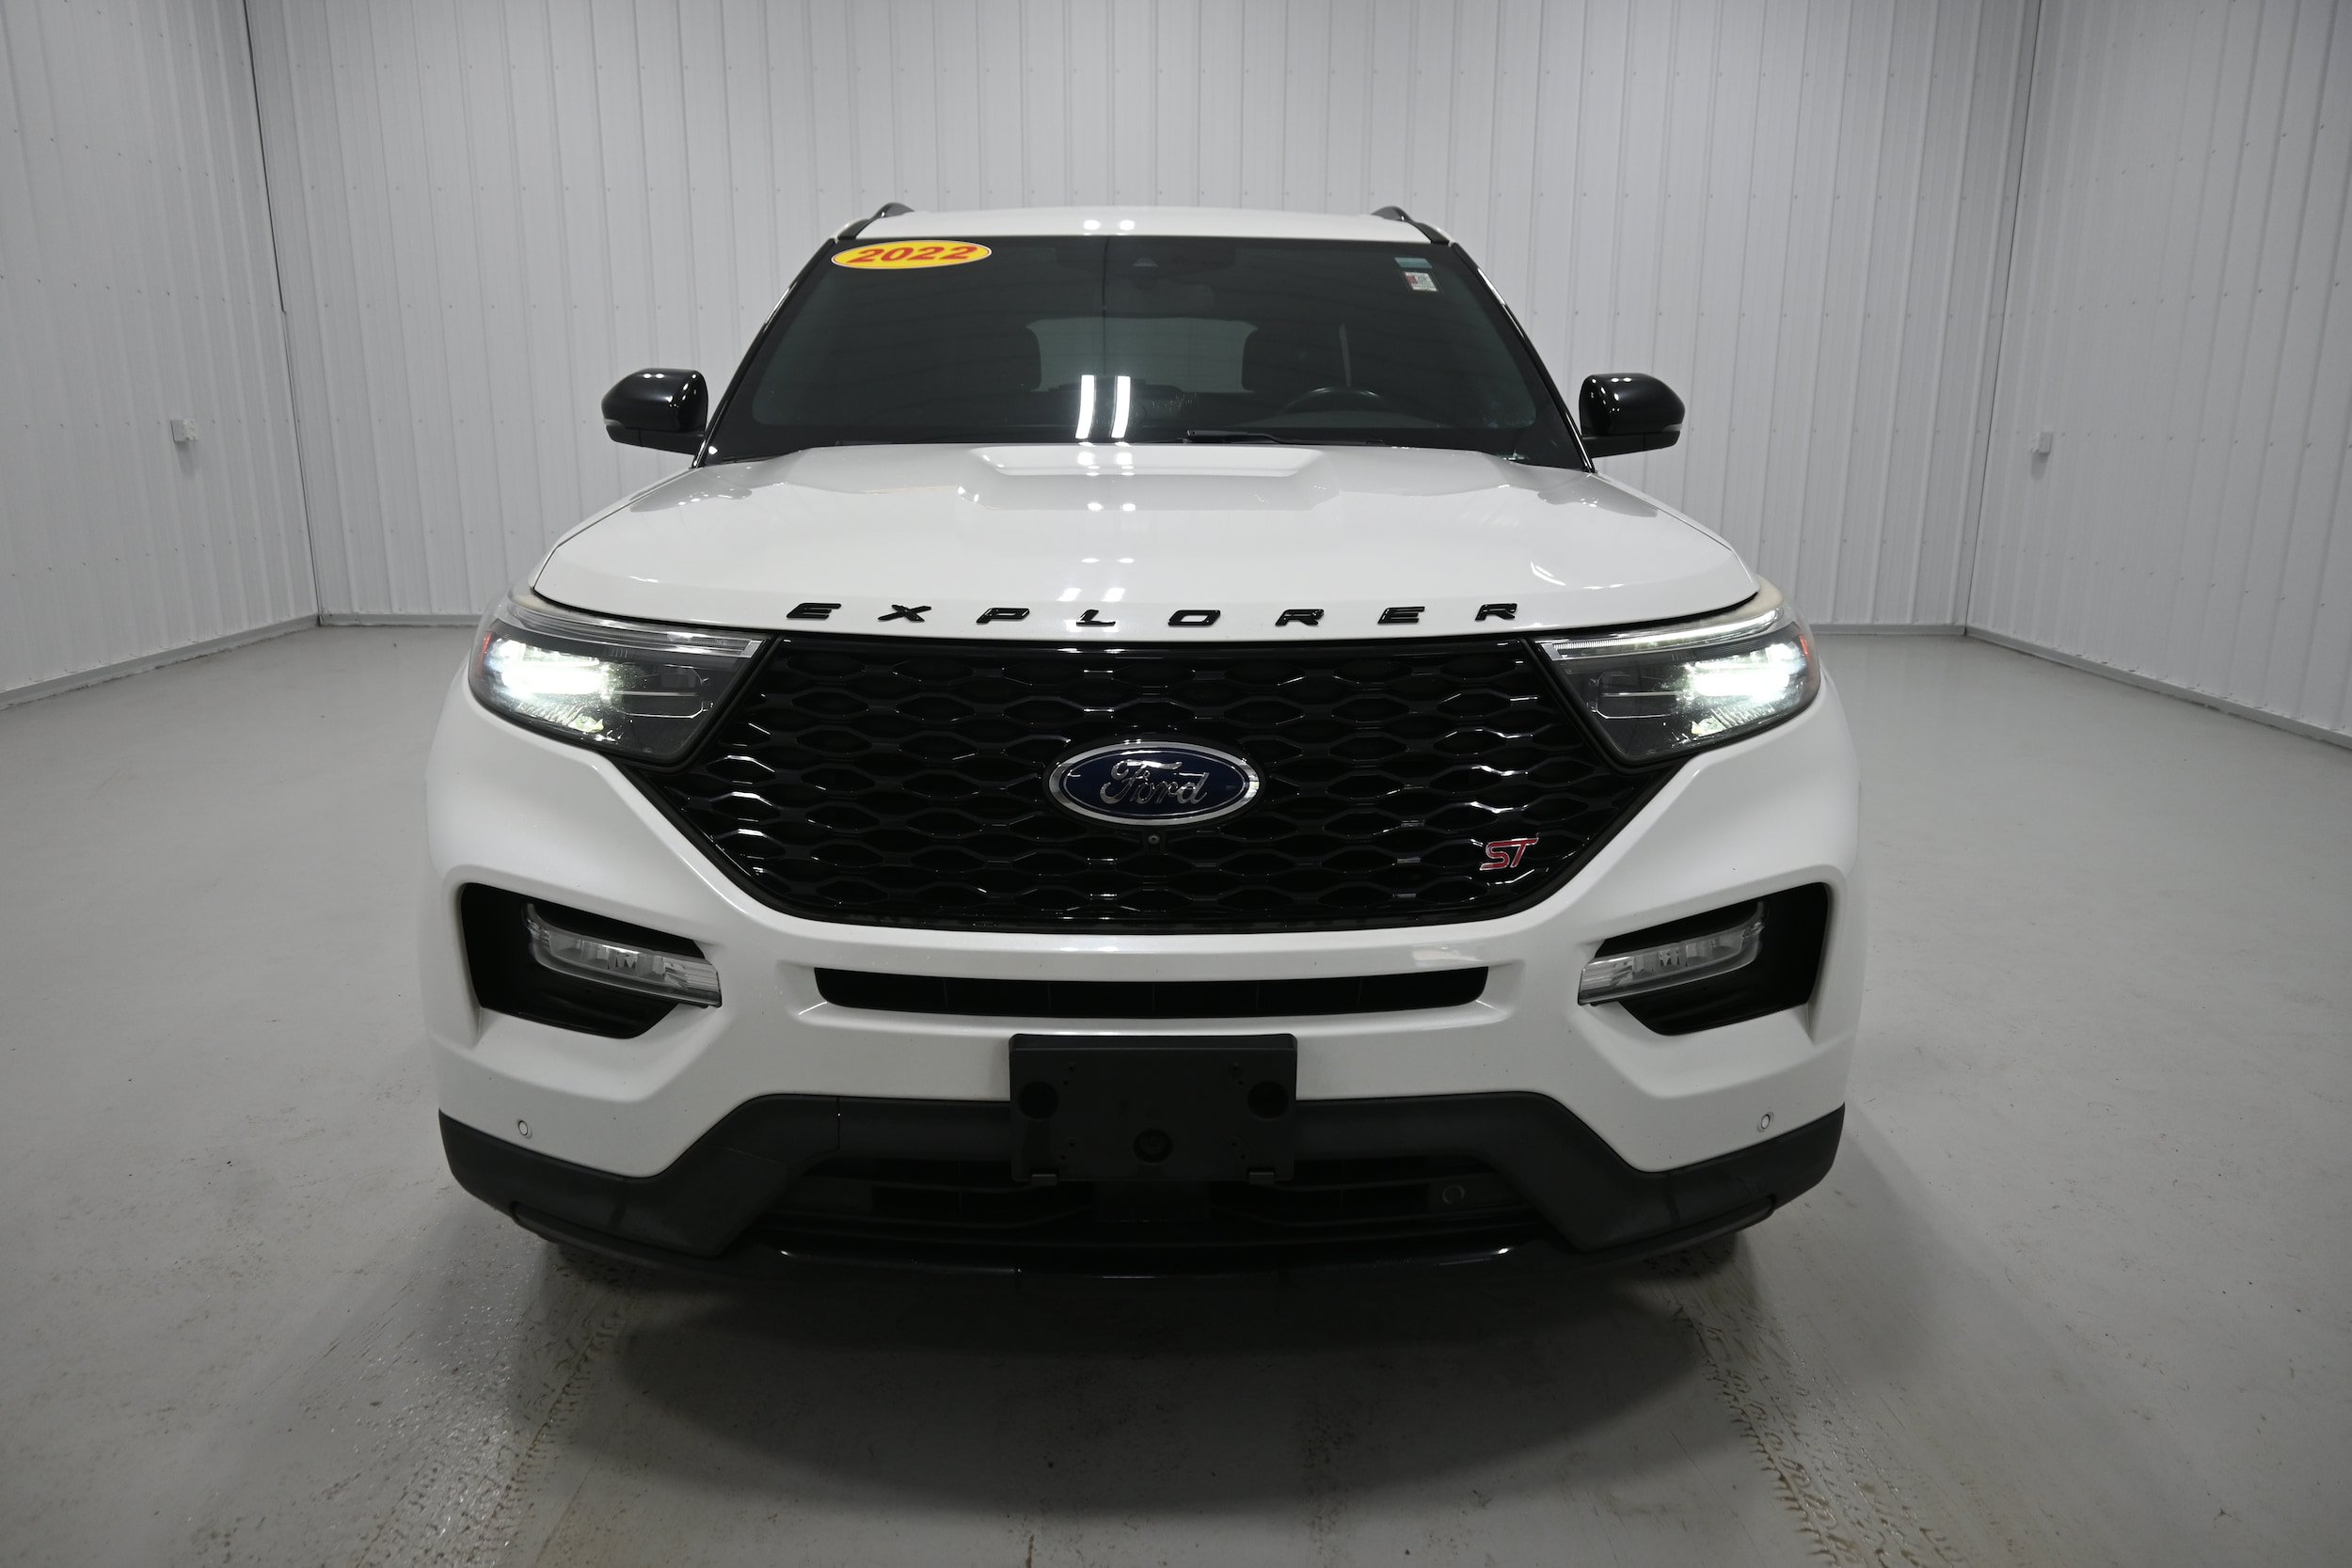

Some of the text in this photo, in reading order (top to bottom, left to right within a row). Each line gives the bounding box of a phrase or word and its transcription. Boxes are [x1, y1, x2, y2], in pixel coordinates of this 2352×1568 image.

[846, 245, 978, 264] 2022
[786, 602, 1518, 627] EXPLORER
[1099, 759, 1210, 804] Ford
[1479, 837, 1540, 871] ST
